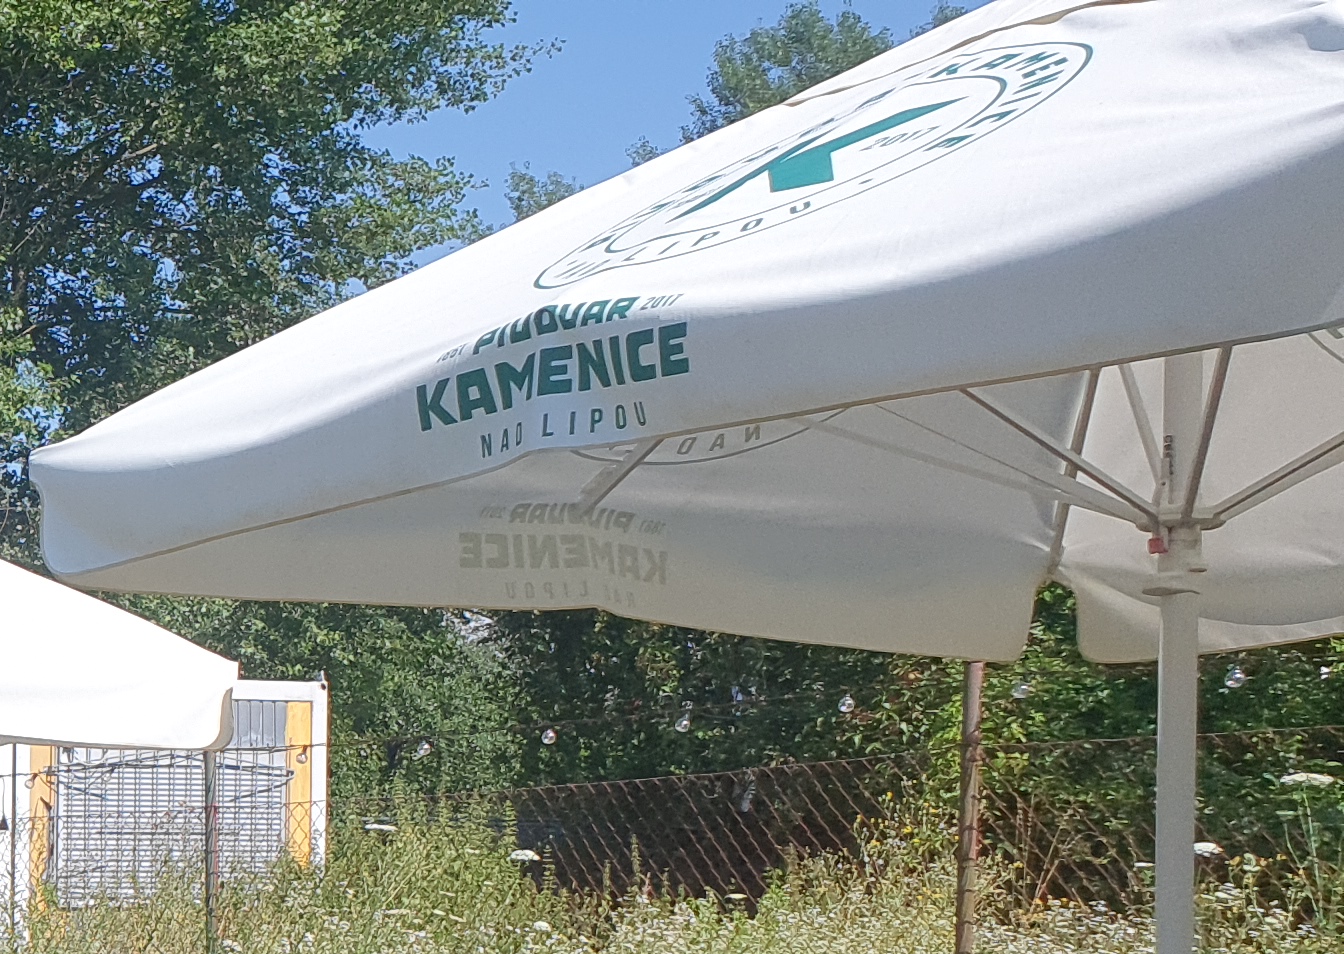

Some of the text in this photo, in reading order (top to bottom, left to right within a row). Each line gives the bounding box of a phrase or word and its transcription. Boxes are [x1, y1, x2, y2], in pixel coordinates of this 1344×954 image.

[665, 95, 969, 224] K
[621, 200, 812, 262] LIPOU
[640, 293, 685, 311] 2017
[415, 321, 691, 432] KAMENICE
[480, 401, 647, 459] NAD LIPOU
